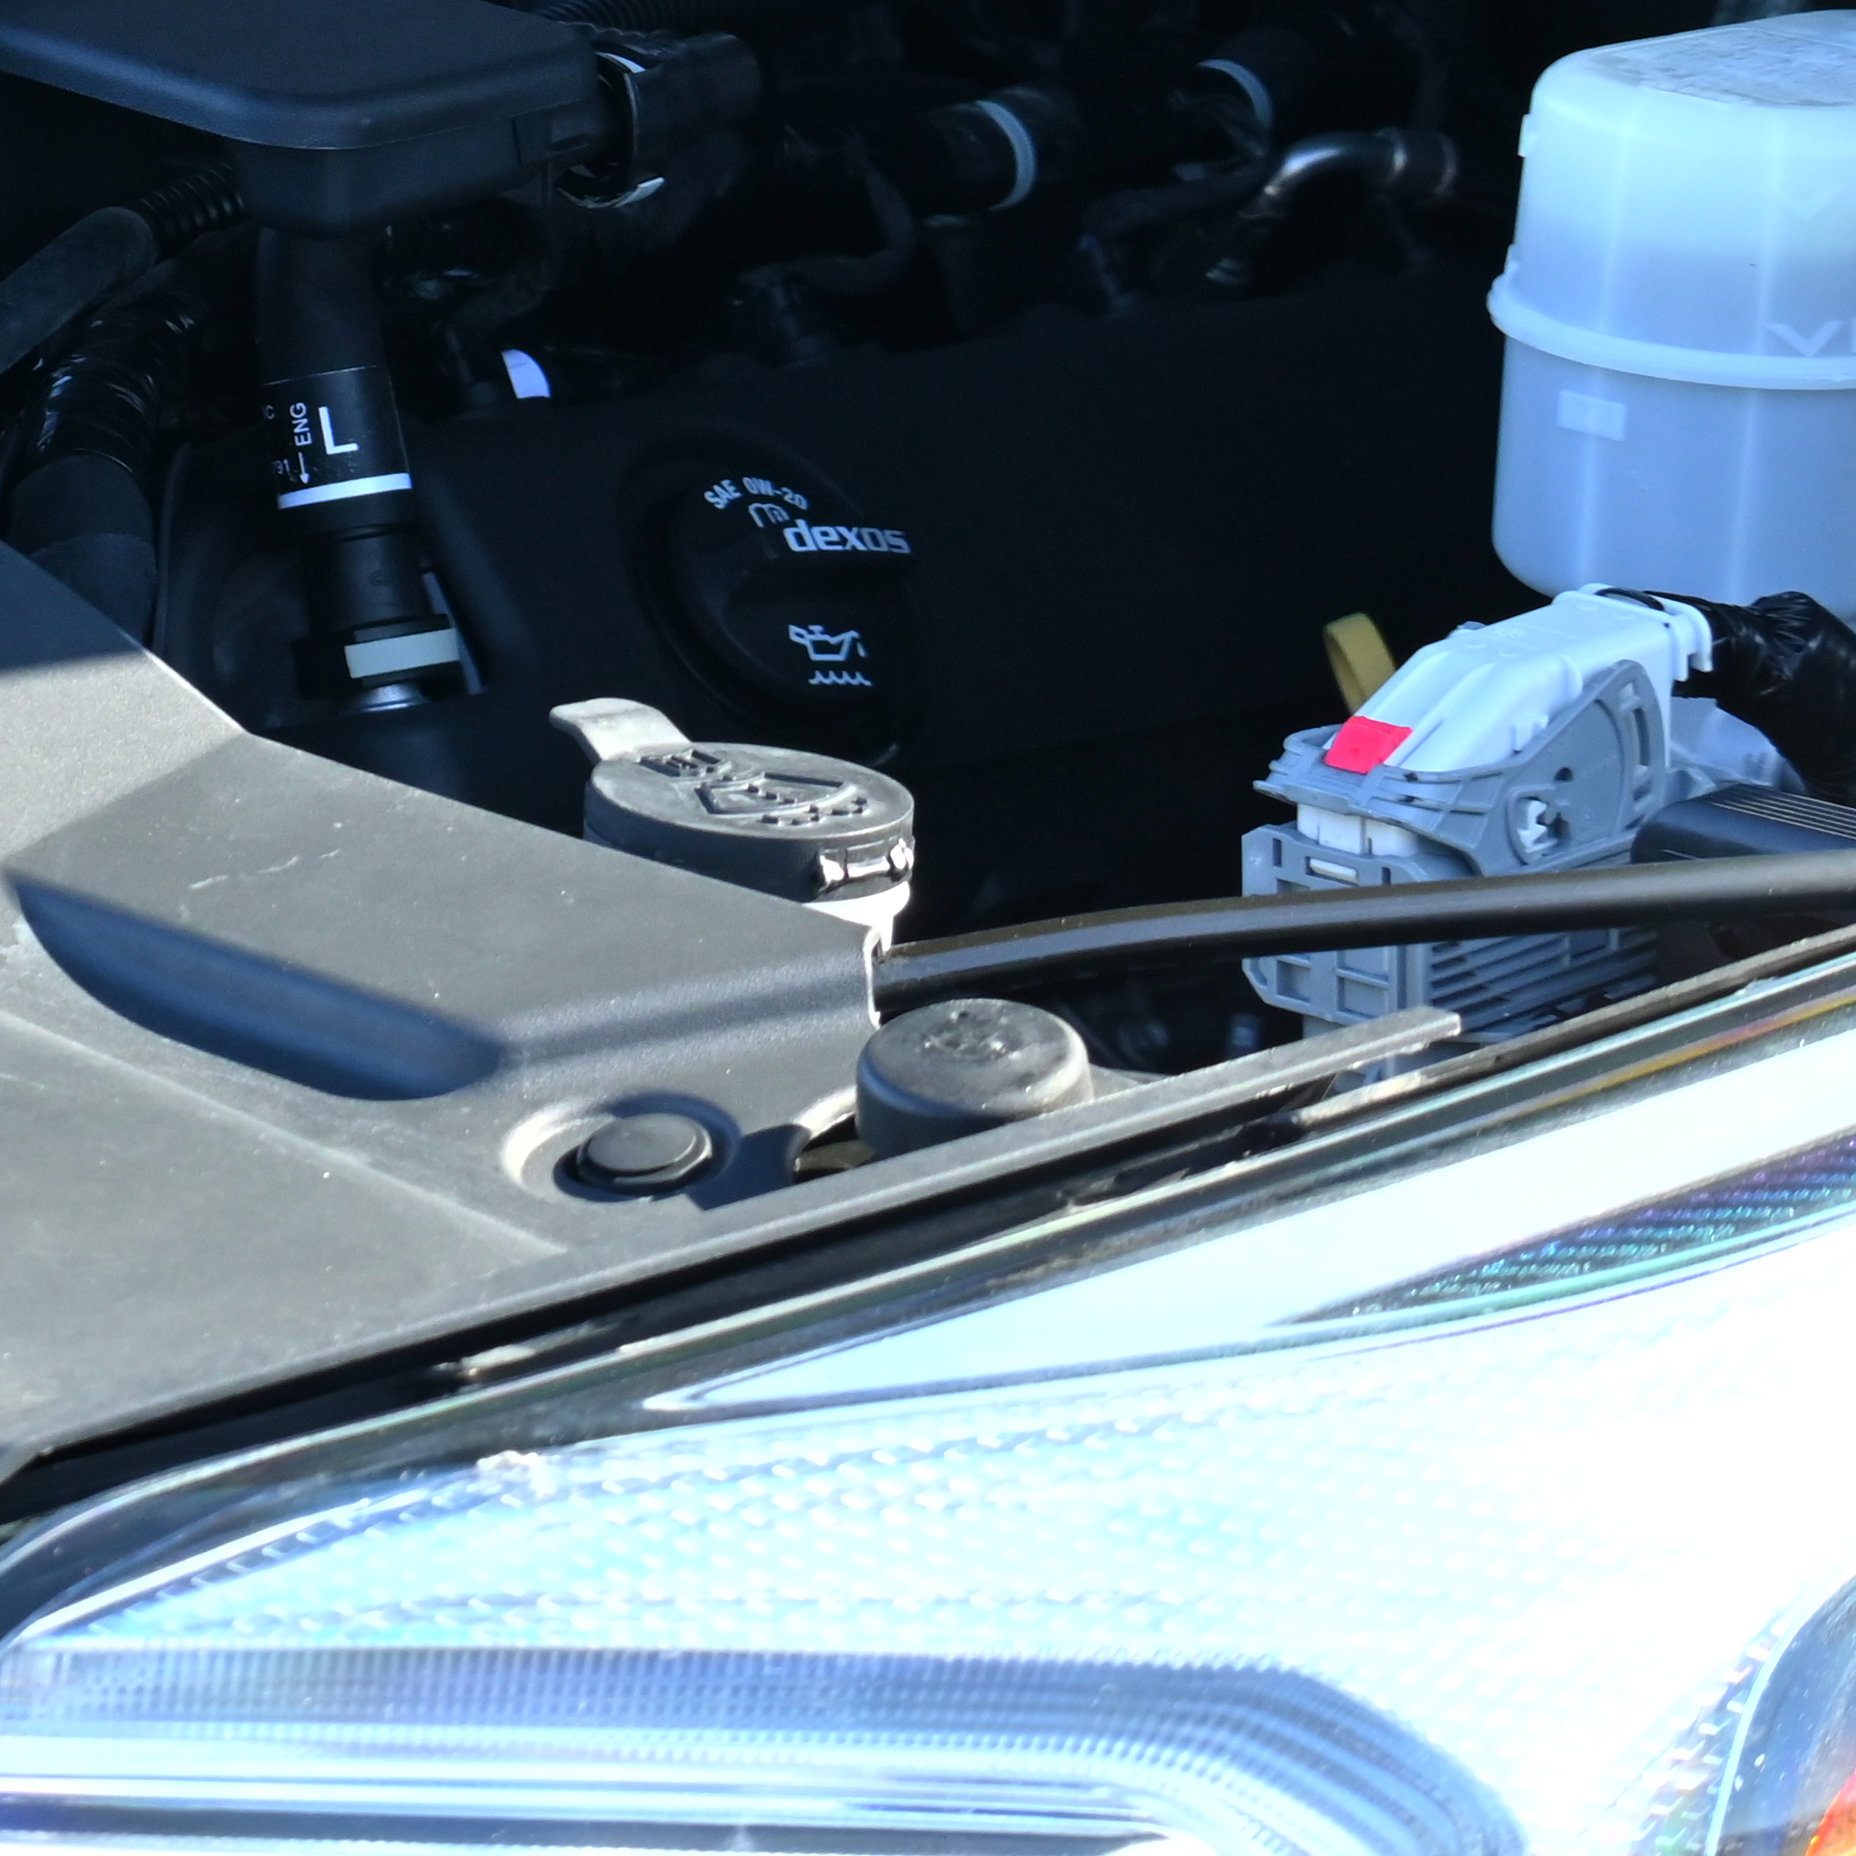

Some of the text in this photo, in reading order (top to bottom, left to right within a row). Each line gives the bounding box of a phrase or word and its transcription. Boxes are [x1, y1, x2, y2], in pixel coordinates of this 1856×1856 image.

[289, 401, 313, 447] ENG
[317, 405, 360, 456] L
[703, 478, 743, 511] SAE
[782, 517, 913, 555] dexos
